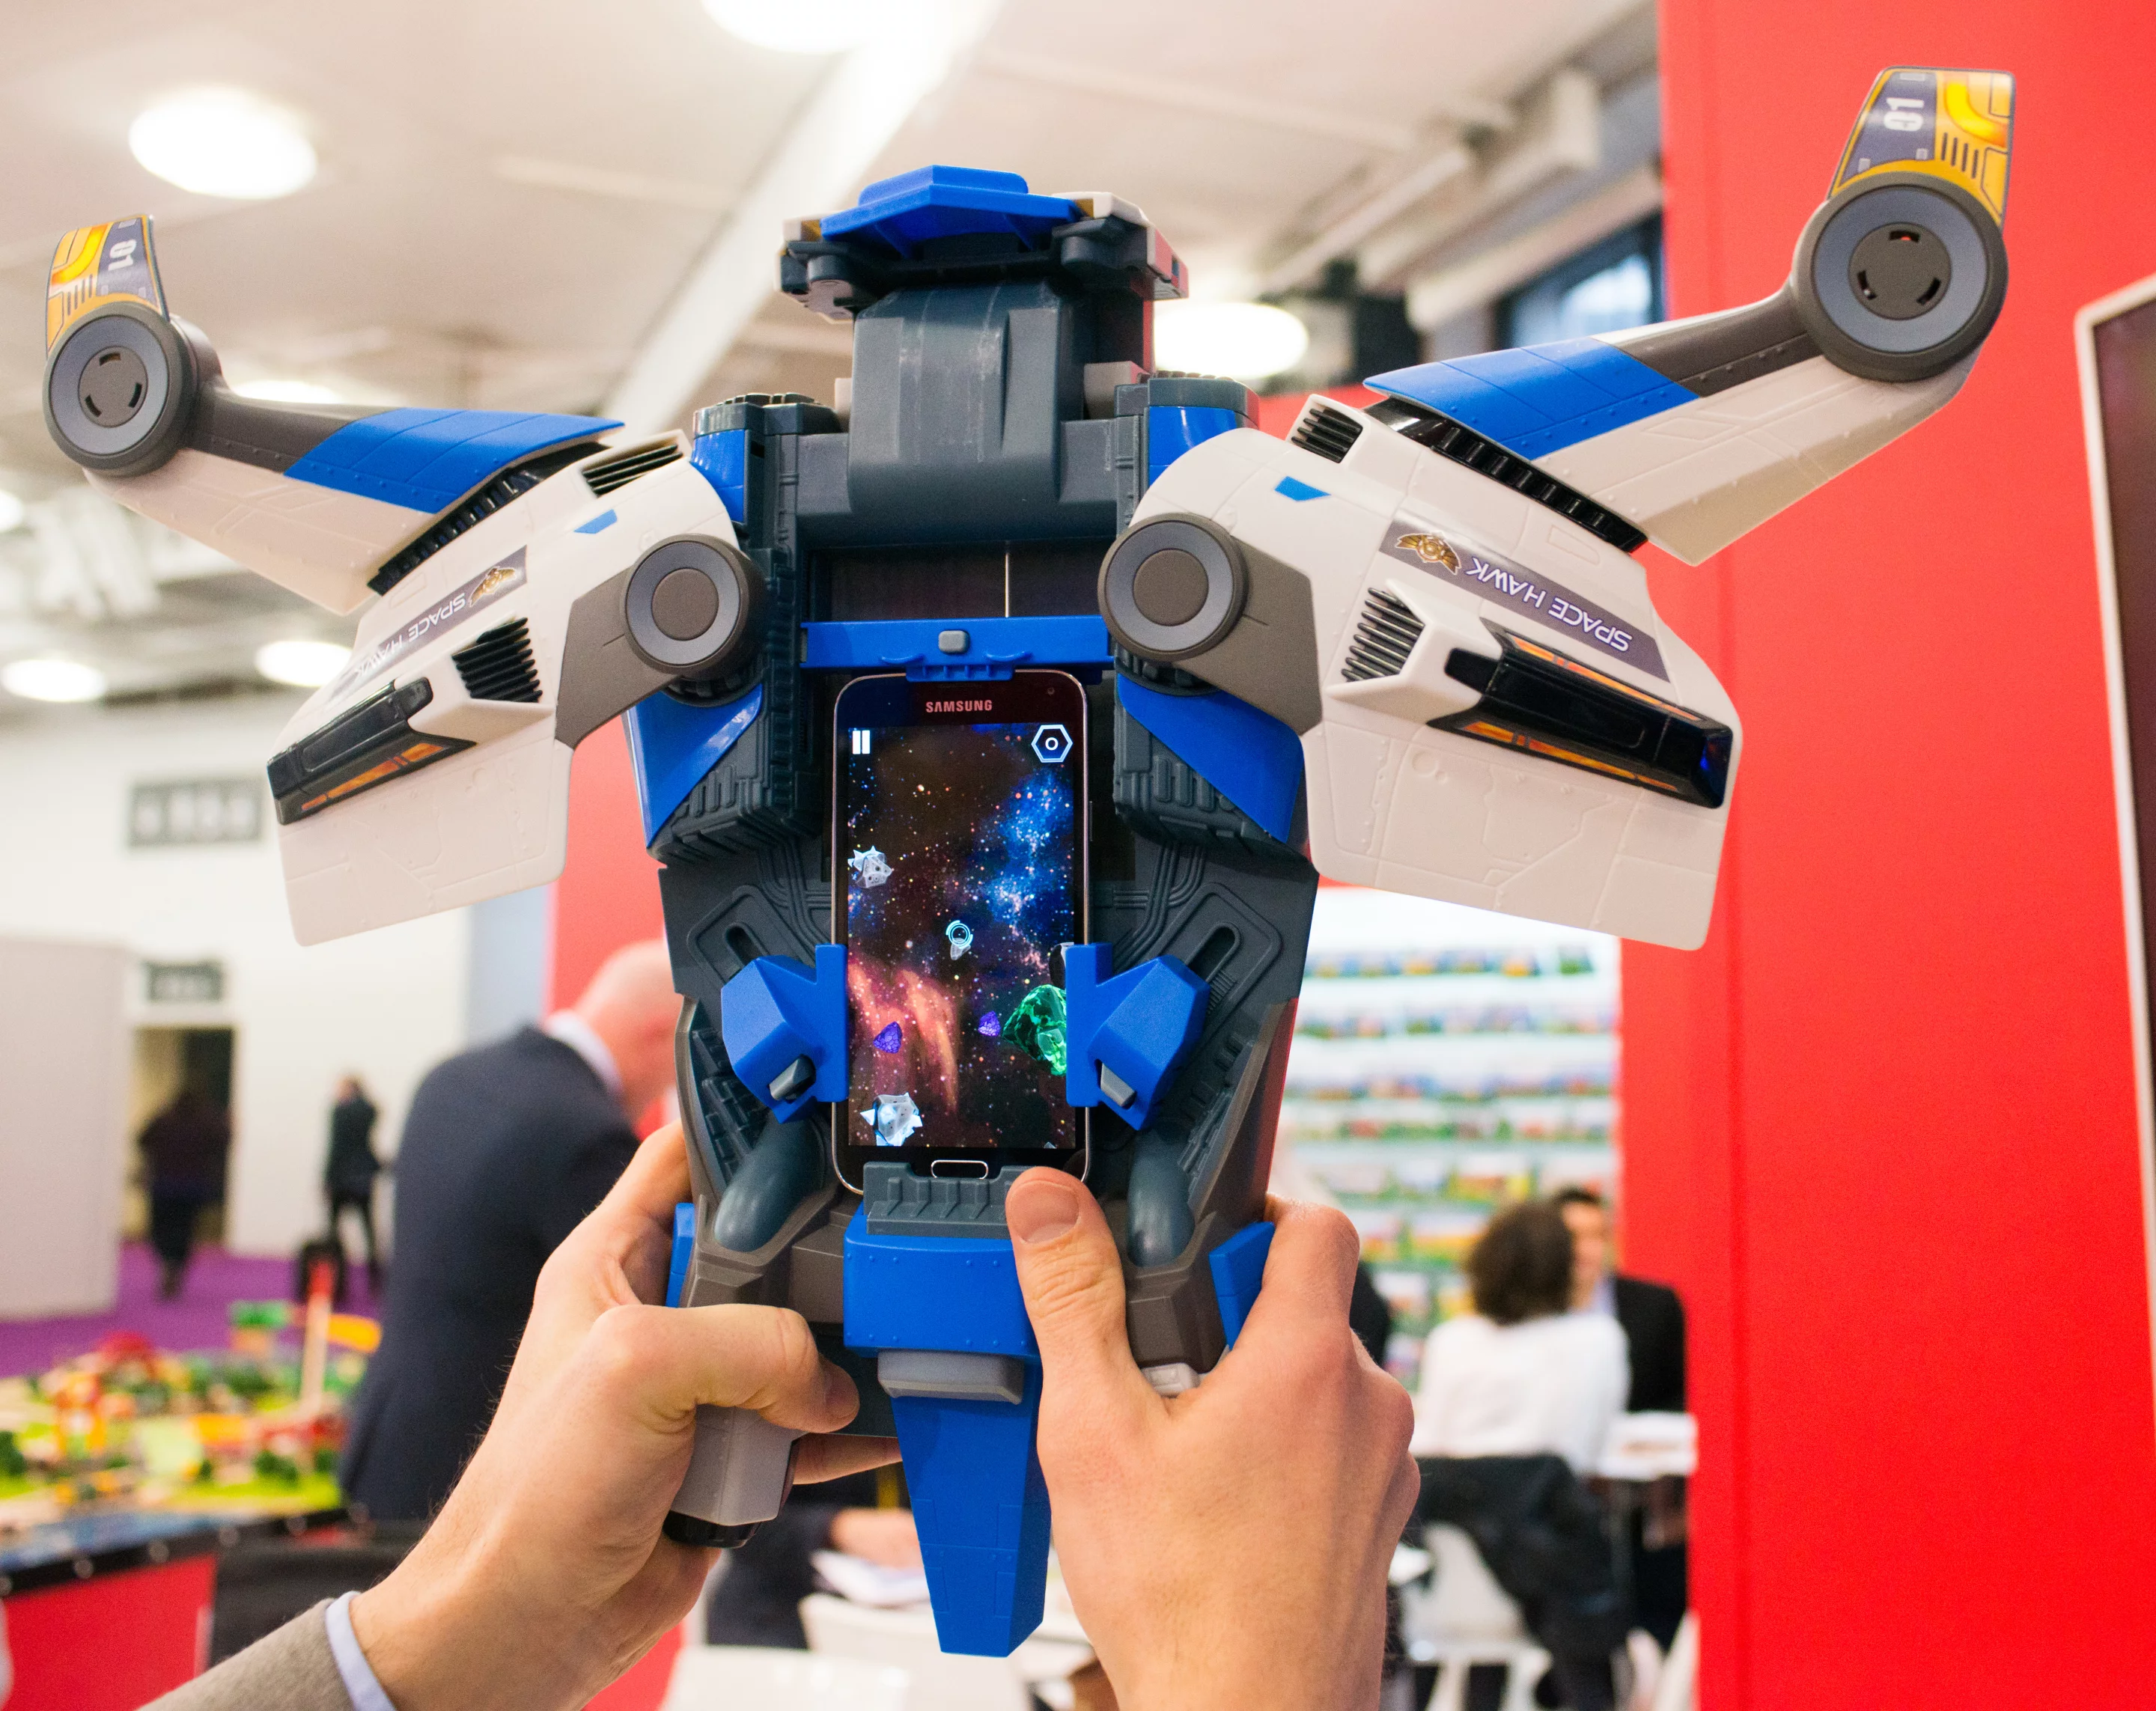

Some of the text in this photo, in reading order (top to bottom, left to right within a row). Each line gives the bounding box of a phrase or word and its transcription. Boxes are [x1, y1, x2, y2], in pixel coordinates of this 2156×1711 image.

[1883, 97, 1925, 132] 01
[108, 239, 137, 271] 01
[407, 592, 466, 641] SPACE
[1465, 557, 1633, 653] SPACE HAWK
[925, 699, 993, 713] SAMSUNG
